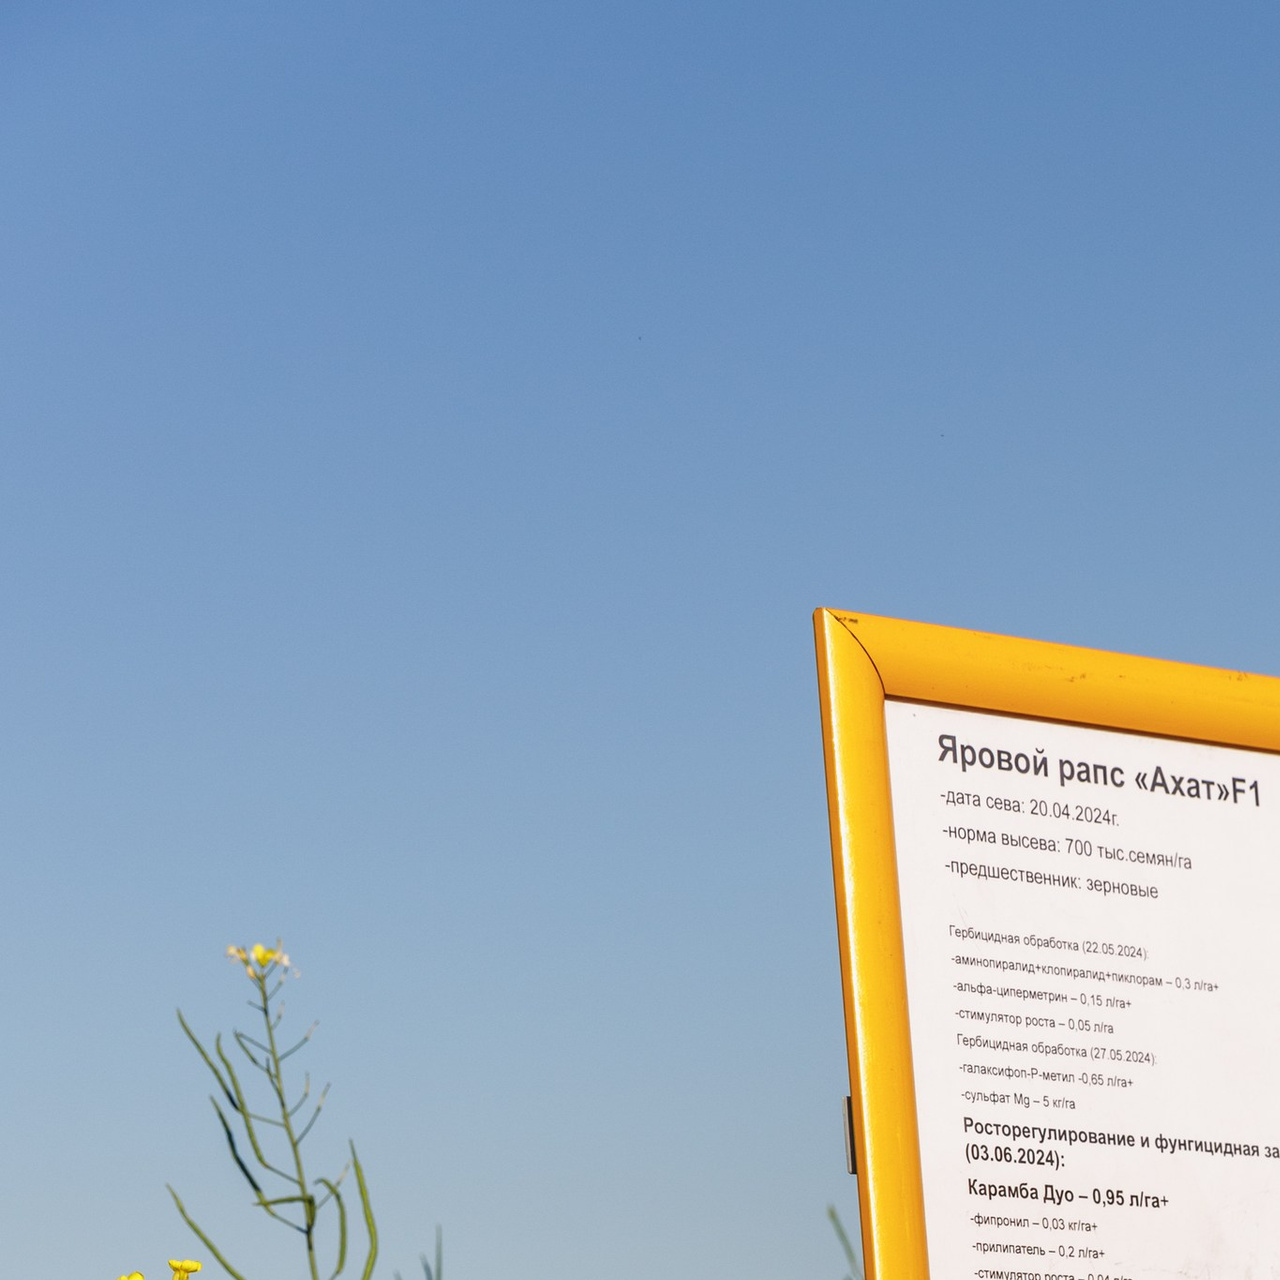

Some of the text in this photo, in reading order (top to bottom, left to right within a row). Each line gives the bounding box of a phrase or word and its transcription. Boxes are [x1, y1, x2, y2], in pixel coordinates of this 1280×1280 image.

[937, 733, 1049, 778] Яровой
[1058, 758, 1126, 789] рапс
[940, 790, 1120, 827] -дата сева: 20.04.2024г.
[942, 825, 1193, 870] -норма высева: 700 тыс.семян/га
[944, 860, 1159, 900] -предшественник: зерновые
[948, 924, 1021, 945] Гербицидная
[1022, 934, 1080, 952] обработка
[950, 954, 1164, 988] -аминопиралид+клопиралид+пиклорам
[1174, 976, 1192, 990] 0,3
[1193, 980, 1219, 993] л/га+
[953, 982, 1068, 1004] -альфа-циперметрин
[1079, 992, 1103, 1007] 0,15
[1105, 996, 1132, 1009] л/га+
[955, 1009, 1023, 1028] -стимулятор
[1024, 1016, 1056, 1029] роста
[1067, 1017, 1092, 1032] 0,05
[1093, 1021, 1115, 1035] л/га
[956, 1032, 1029, 1053] Гербицидная
[1031, 1041, 1088, 1058] обработка
[1077, 1072, 1105, 1087] -0,65
[1106, 1075, 1134, 1088] л/га+
[960, 1090, 1011, 1106] -сульфат
[1013, 1092, 1031, 1109] Mg
[1042, 1095, 1050, 1108] 5
[1052, 1096, 1076, 1110] кг/га
[963, 1116, 1136, 1148] Росторегулирование
[1139, 1135, 1150, 1149] и
[1154, 1133, 1260, 1158] фунгицидная
[967, 1177, 1040, 1201] Карамба
[1042, 1183, 1075, 1206] Дуо
[1092, 1187, 1125, 1208] 0,95
[1128, 1190, 1170, 1209] л/га+
[969, 1212, 1030, 1229] -фипронил
[1041, 1216, 1066, 1232] 0,03
[1067, 1219, 1098, 1233] кг/га+
[971, 1241, 1046, 1256] -прилипатель
[1058, 1244, 1075, 1259] 0,2
[1077, 1246, 1106, 1260] л/га+
